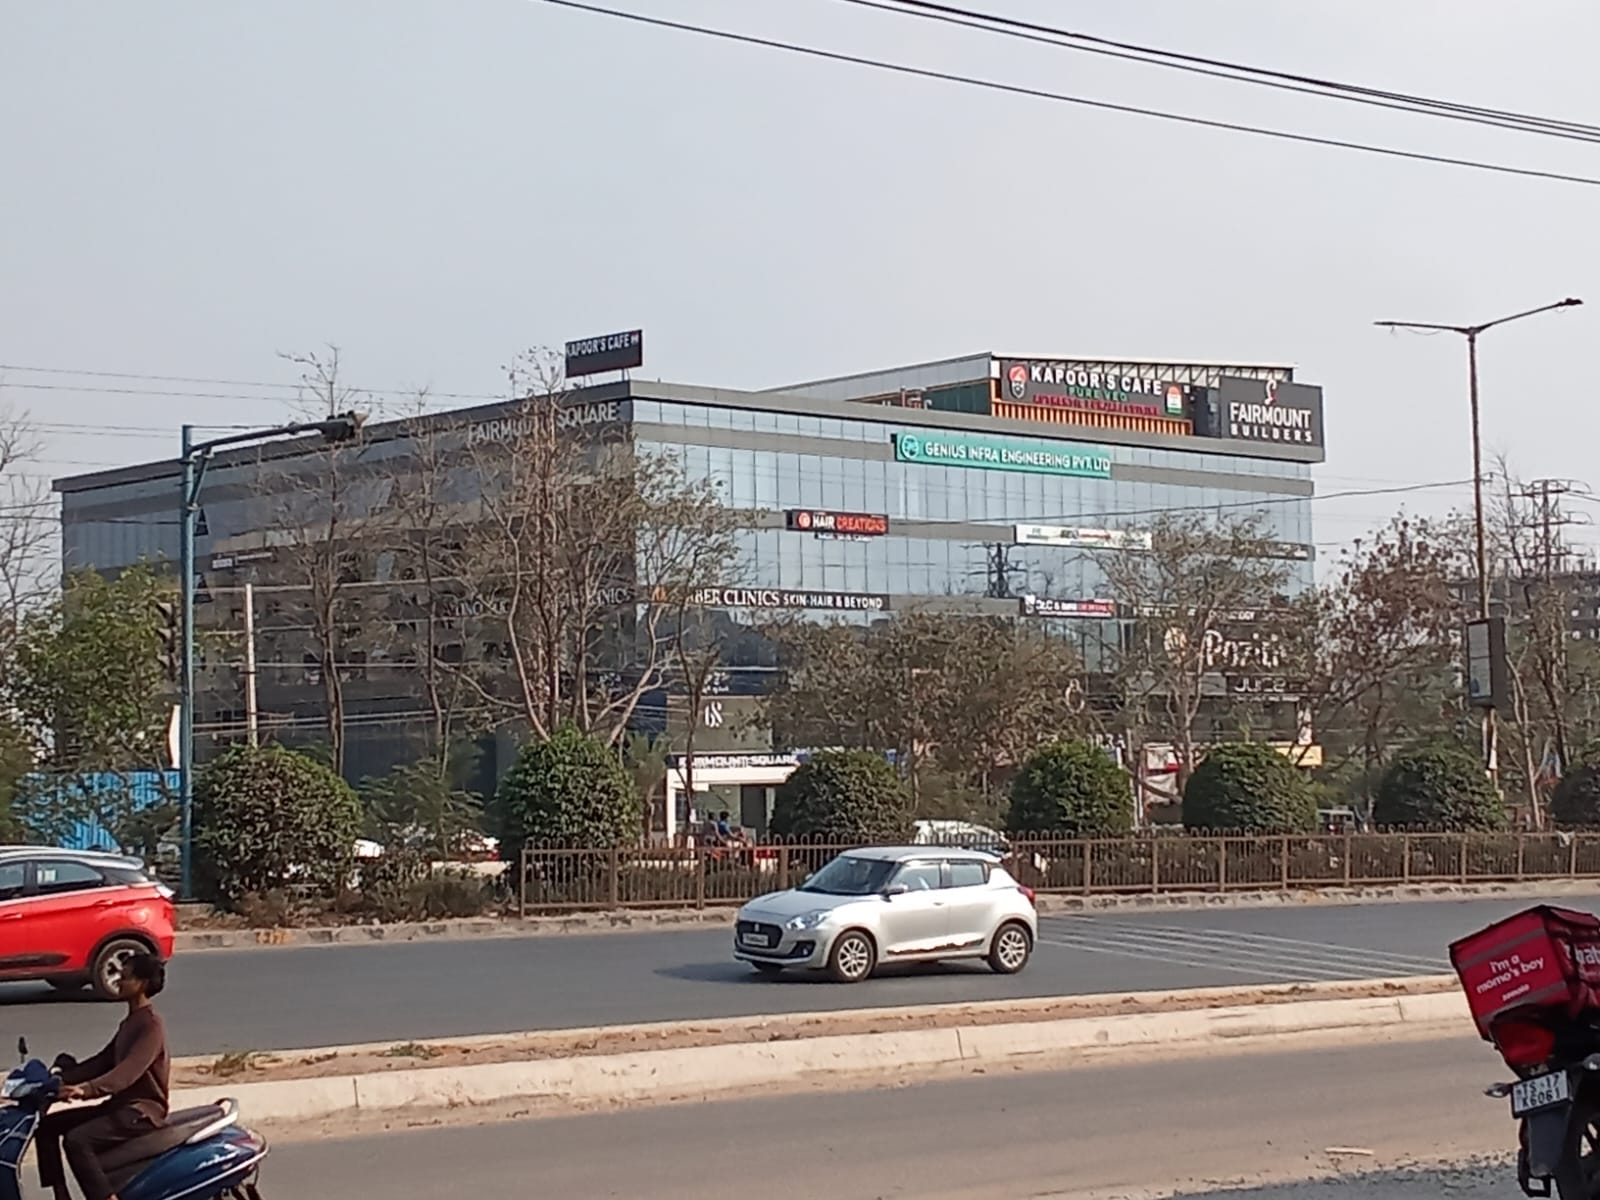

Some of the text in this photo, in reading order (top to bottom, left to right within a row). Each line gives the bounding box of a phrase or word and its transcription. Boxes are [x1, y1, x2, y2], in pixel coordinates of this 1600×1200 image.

[566, 333, 630, 357] KAPOOR'S CAFE
[1030, 366, 1163, 396] KAPOOR'S CAFE
[1067, 387, 1129, 402] PURE VEG
[557, 402, 618, 429] SQUARE
[1229, 402, 1312, 429] FAIRMOUNT
[1230, 424, 1314, 443] BUILDERS
[924, 441, 967, 460] GENIUS
[968, 446, 1000, 463] INFRA
[1000, 448, 1071, 470] ENGINEERING
[812, 515, 887, 532] HAIR CREATIONS
[723, 589, 779, 607] CLINICS
[836, 595, 842, 608] &
[844, 596, 884, 610] BEYOND
[1511, 954, 1521, 964] a
[1476, 957, 1545, 994] momo's boy
[1522, 1074, 1560, 1097] TS 17
